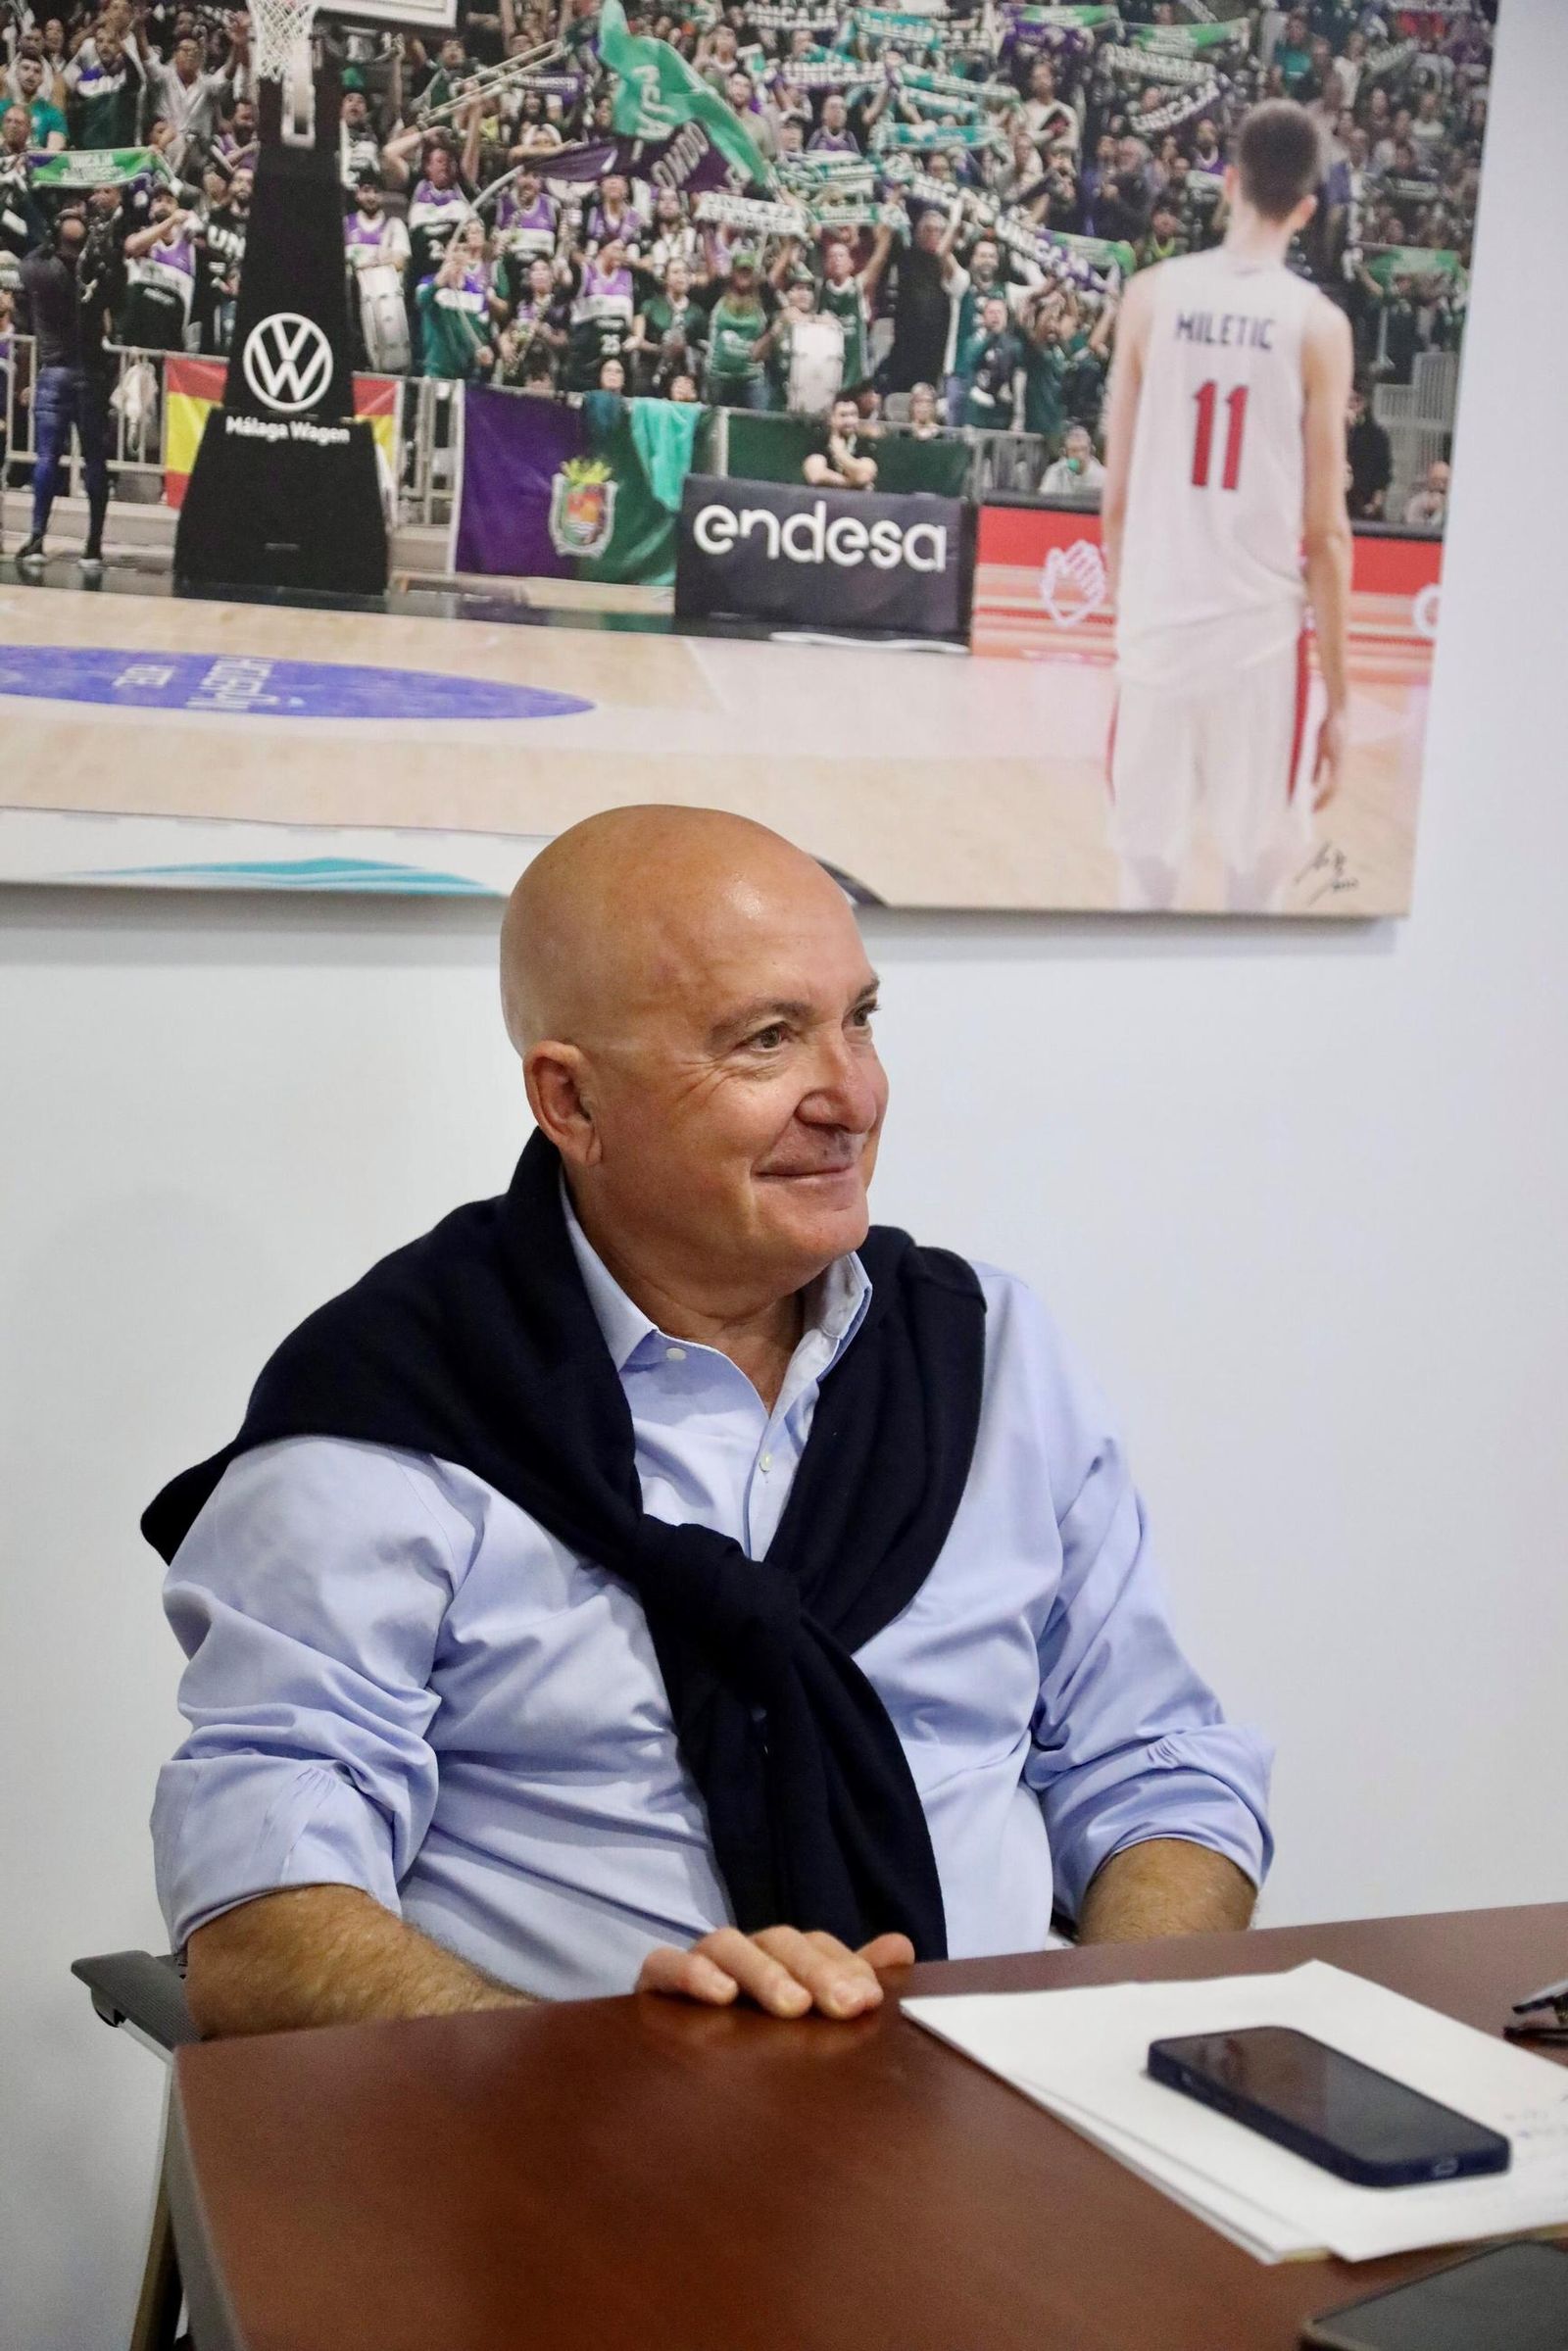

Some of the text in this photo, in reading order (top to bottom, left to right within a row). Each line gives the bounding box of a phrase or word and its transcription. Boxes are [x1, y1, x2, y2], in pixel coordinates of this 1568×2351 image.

[1175, 312, 1275, 351] MILETIC
[225, 416, 351, 447] Málaga Wagen
[1191, 378, 1250, 491] 11
[693, 500, 948, 573] endesa
